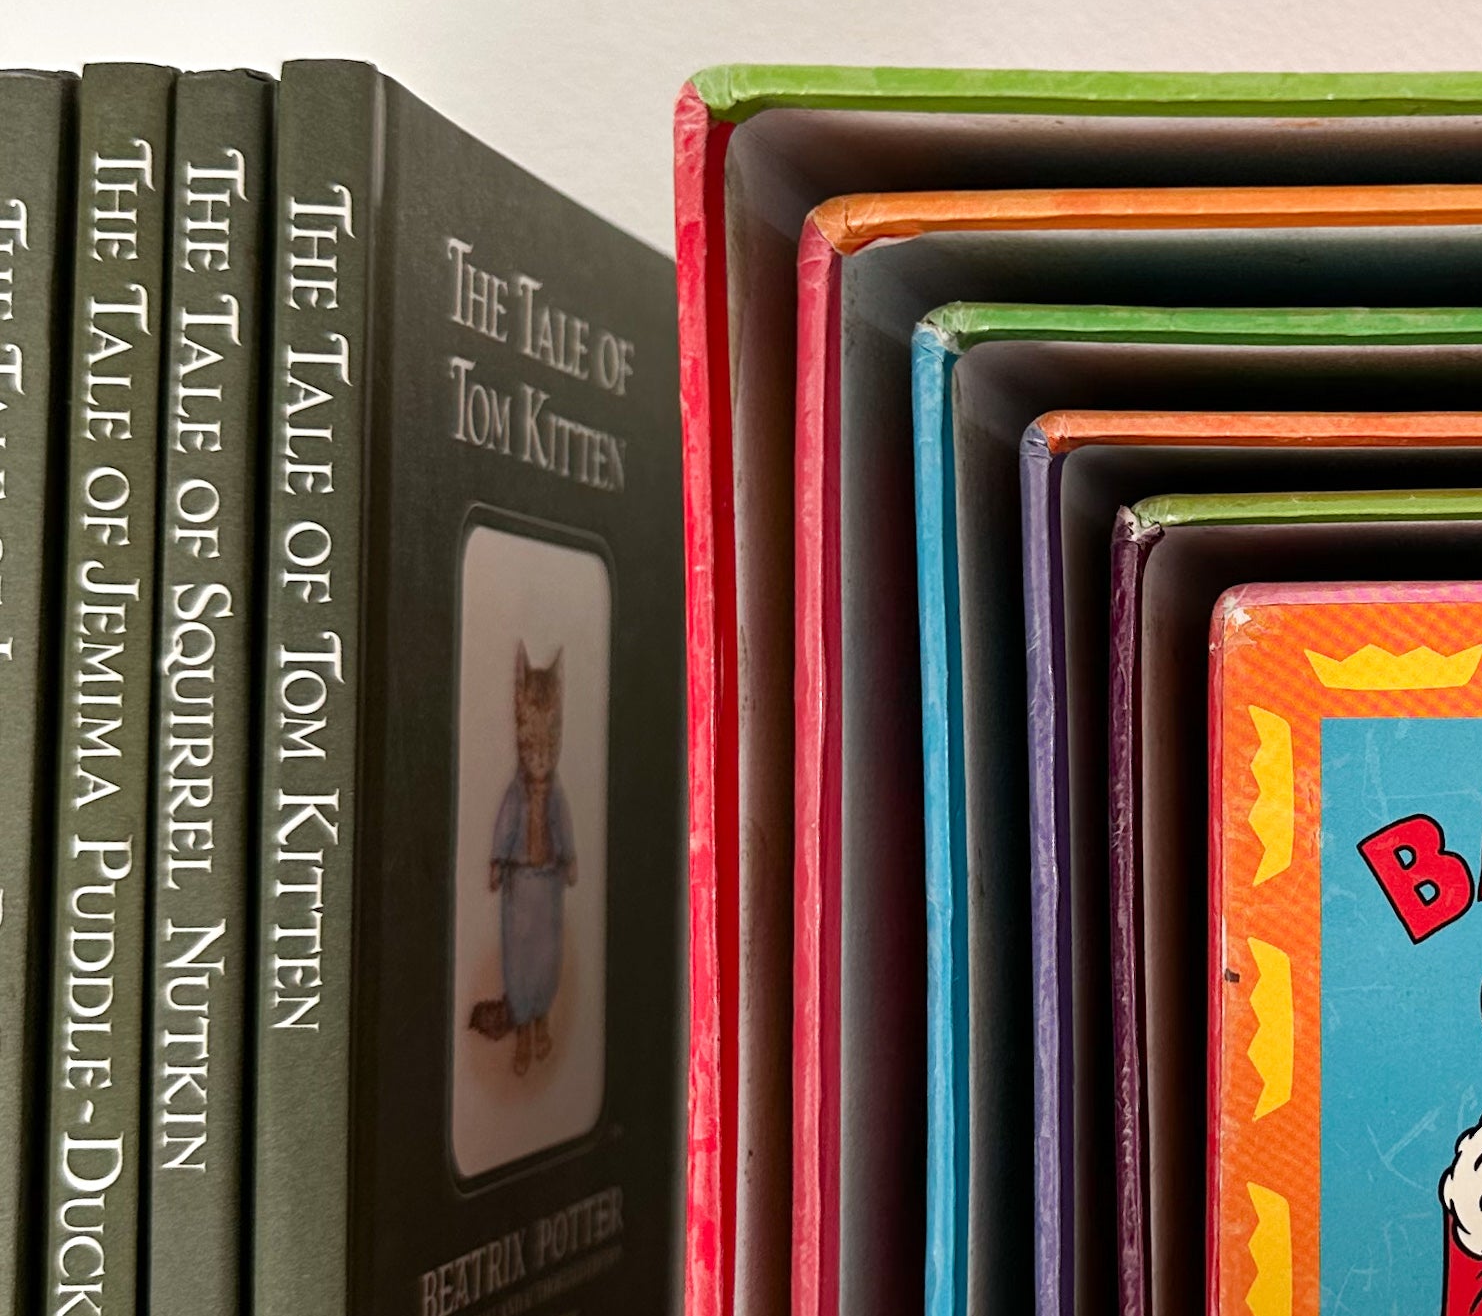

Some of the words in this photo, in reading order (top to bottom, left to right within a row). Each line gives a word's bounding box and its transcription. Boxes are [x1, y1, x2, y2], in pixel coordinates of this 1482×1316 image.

[91, 138, 154, 262] THE
[182, 148, 249, 273] THE
[287, 184, 356, 310] THE
[83, 283, 151, 441] TALE
[173, 293, 242, 454] TALE
[448, 237, 509, 343] THE
[517, 274, 590, 381] TALE
[598, 333, 635, 396] OF
[282, 333, 352, 495] TALE
[450, 356, 511, 455] TOM
[521, 383, 627, 493] KITTEN
[81, 466, 131, 546] OF
[171, 478, 220, 559] OF
[280, 521, 332, 603] OF
[73, 560, 140, 810] JEMIMA
[160, 583, 234, 890] SQUIRREL
[277, 631, 344, 763] TOM
[271, 788, 340, 1031] KITTEN
[158, 918, 227, 1173] NUTKIN
[533, 1185, 624, 1272] POTTER
